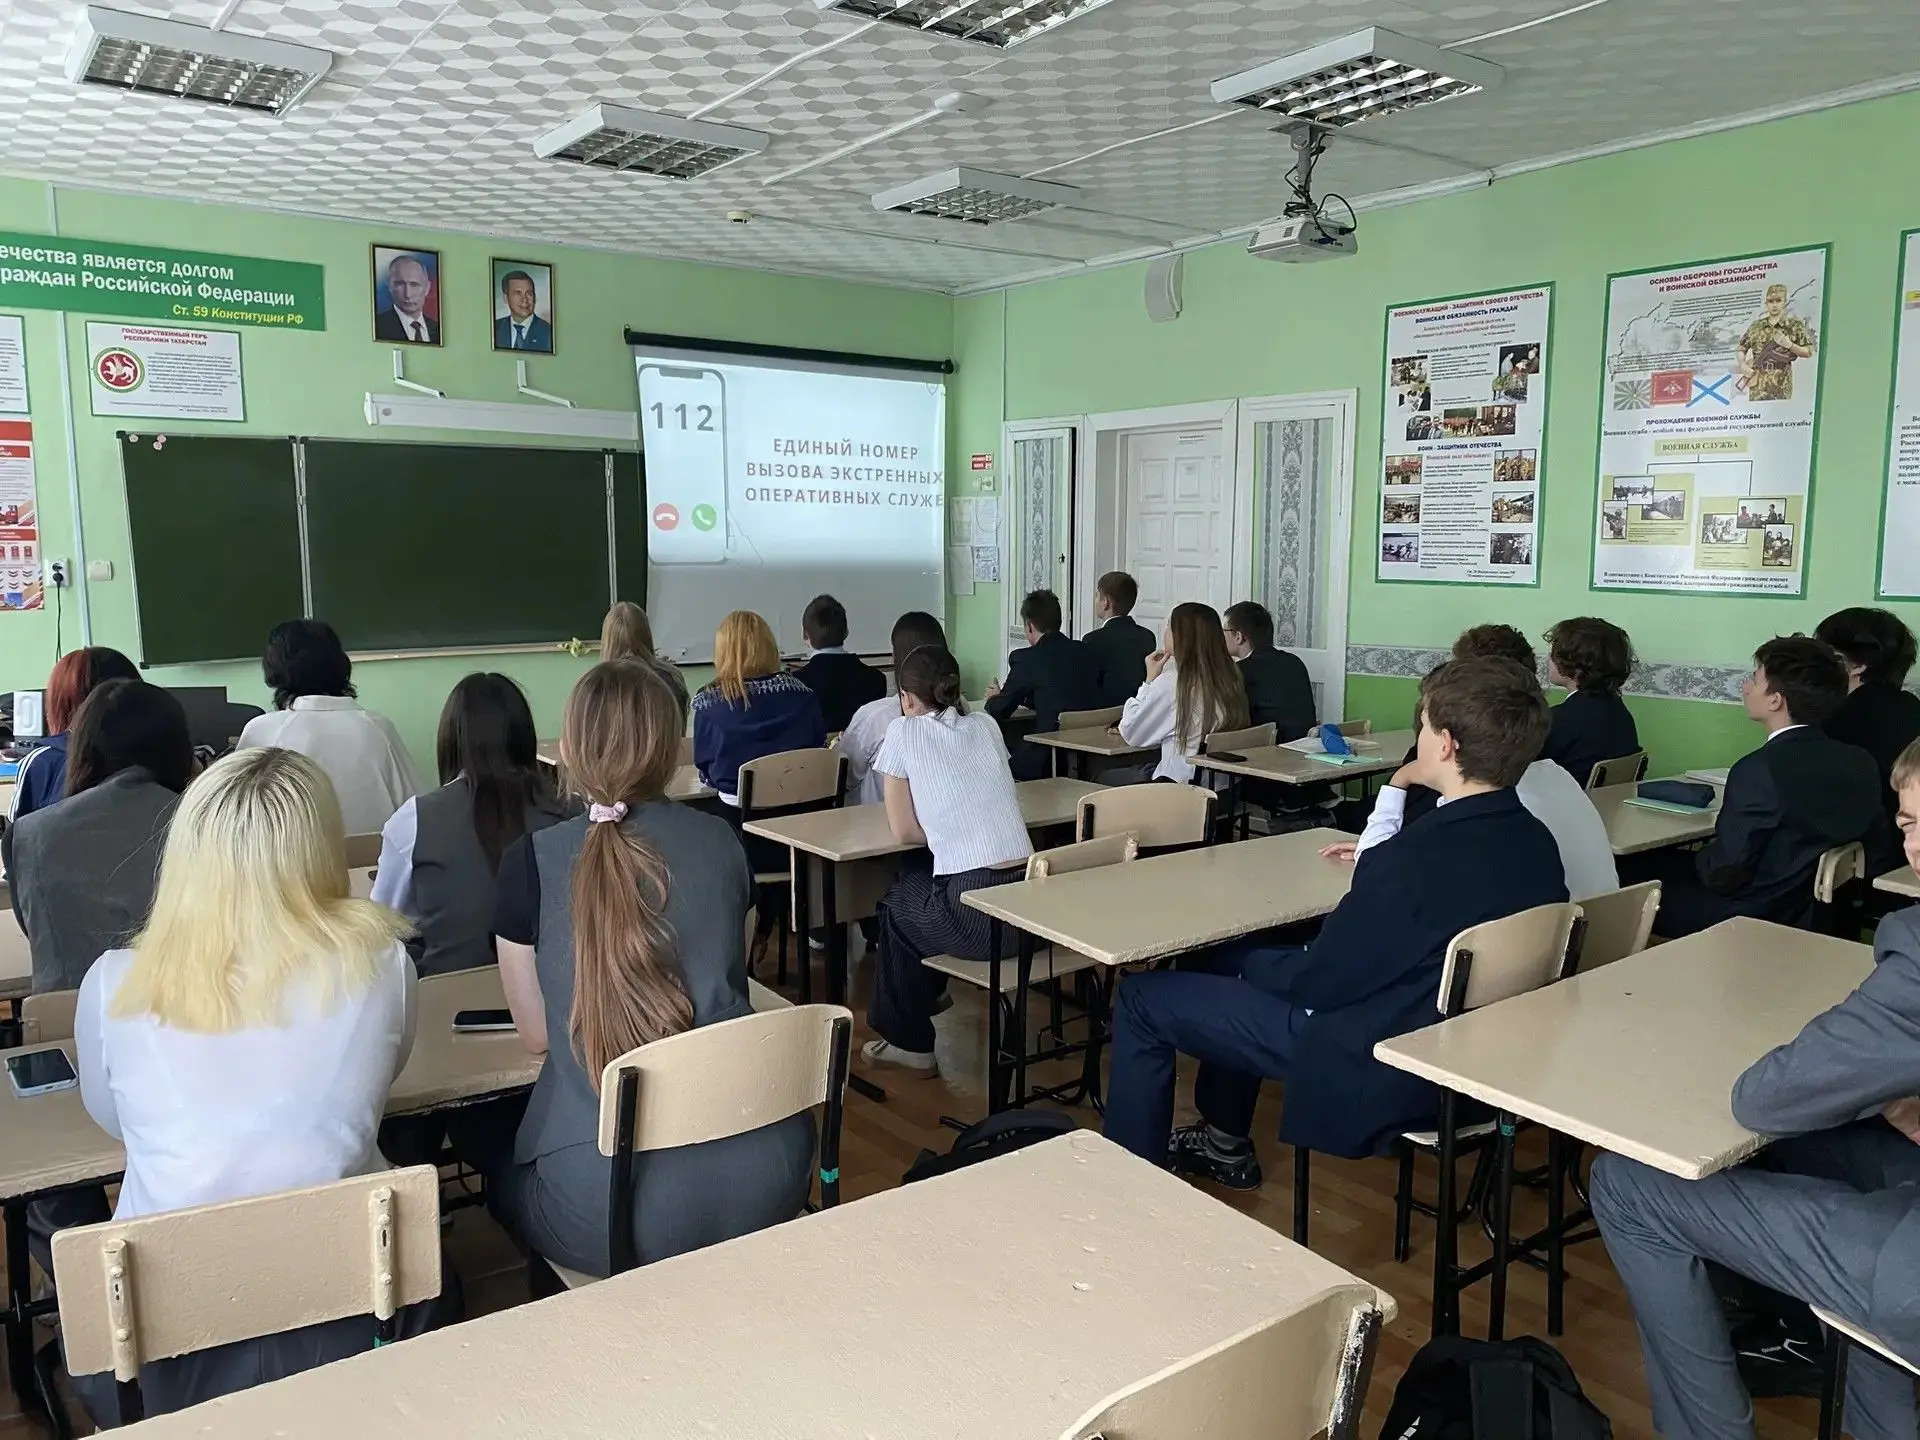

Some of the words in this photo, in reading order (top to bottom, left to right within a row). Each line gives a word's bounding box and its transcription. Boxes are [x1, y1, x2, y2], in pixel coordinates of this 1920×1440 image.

[82, 253, 167, 274] является
[171, 261, 234, 280] долгом
[1649, 275, 1681, 286] ОСНОВЫ
[1683, 270, 1722, 281] ОБОРОНЫ
[1723, 262, 1778, 276] ГОСУДАРСТВА
[81, 271, 192, 297] Российской
[197, 282, 295, 306] Федерации
[1665, 280, 1707, 291] ВОИНСКОЙ
[1708, 273, 1766, 286] ОБЯЗАННОСТИ
[173, 304, 190, 316] Ст.
[193, 305, 208, 317] 59
[211, 307, 284, 323] Конституции
[287, 313, 304, 324] РФ
[1394, 304, 1449, 318] ВОЕННОСЛУЖАЩИЙ
[1452, 300, 1484, 311] ЗАЩИТНИК
[1485, 296, 1508, 305] СВОЕГО
[1509, 292, 1544, 302] ОТЕЧЕСТВА
[1415, 314, 1446, 324] ВОИНСКАЯ
[1446, 309, 1488, 320] ОБЯЗАННОСТЬ
[1489, 305, 1519, 315] ГРАЖДАН
[122, 328, 190, 338] ГОСУДАРСТВЕННЫЙ
[124, 335, 170, 344] РЕСПУБЛИКИ
[171, 338, 207, 346] ТАТАРСТАН
[650, 402, 714, 432] 112
[1646, 416, 1695, 425] ПРОХОЖДЕНИЕ
[1696, 414, 1728, 423] ВОЕННОЙ
[1729, 413, 1761, 421] СЛУЖБЫ
[773, 438, 852, 457] ЕДИНЫЙ
[860, 443, 918, 460] НОМЕР
[1469, 441, 1502, 449] ОТЕЧЕСТВА
[1662, 442, 1701, 451] ВОЕННАЯ
[1702, 441, 1738, 450] СЛУЖБА
[746, 462, 823, 479] ВЫЗОВА
[830, 466, 944, 485] ЭКСТРЕННЫХ
[745, 487, 880, 505] ОПЕРАТИВНЫХ
